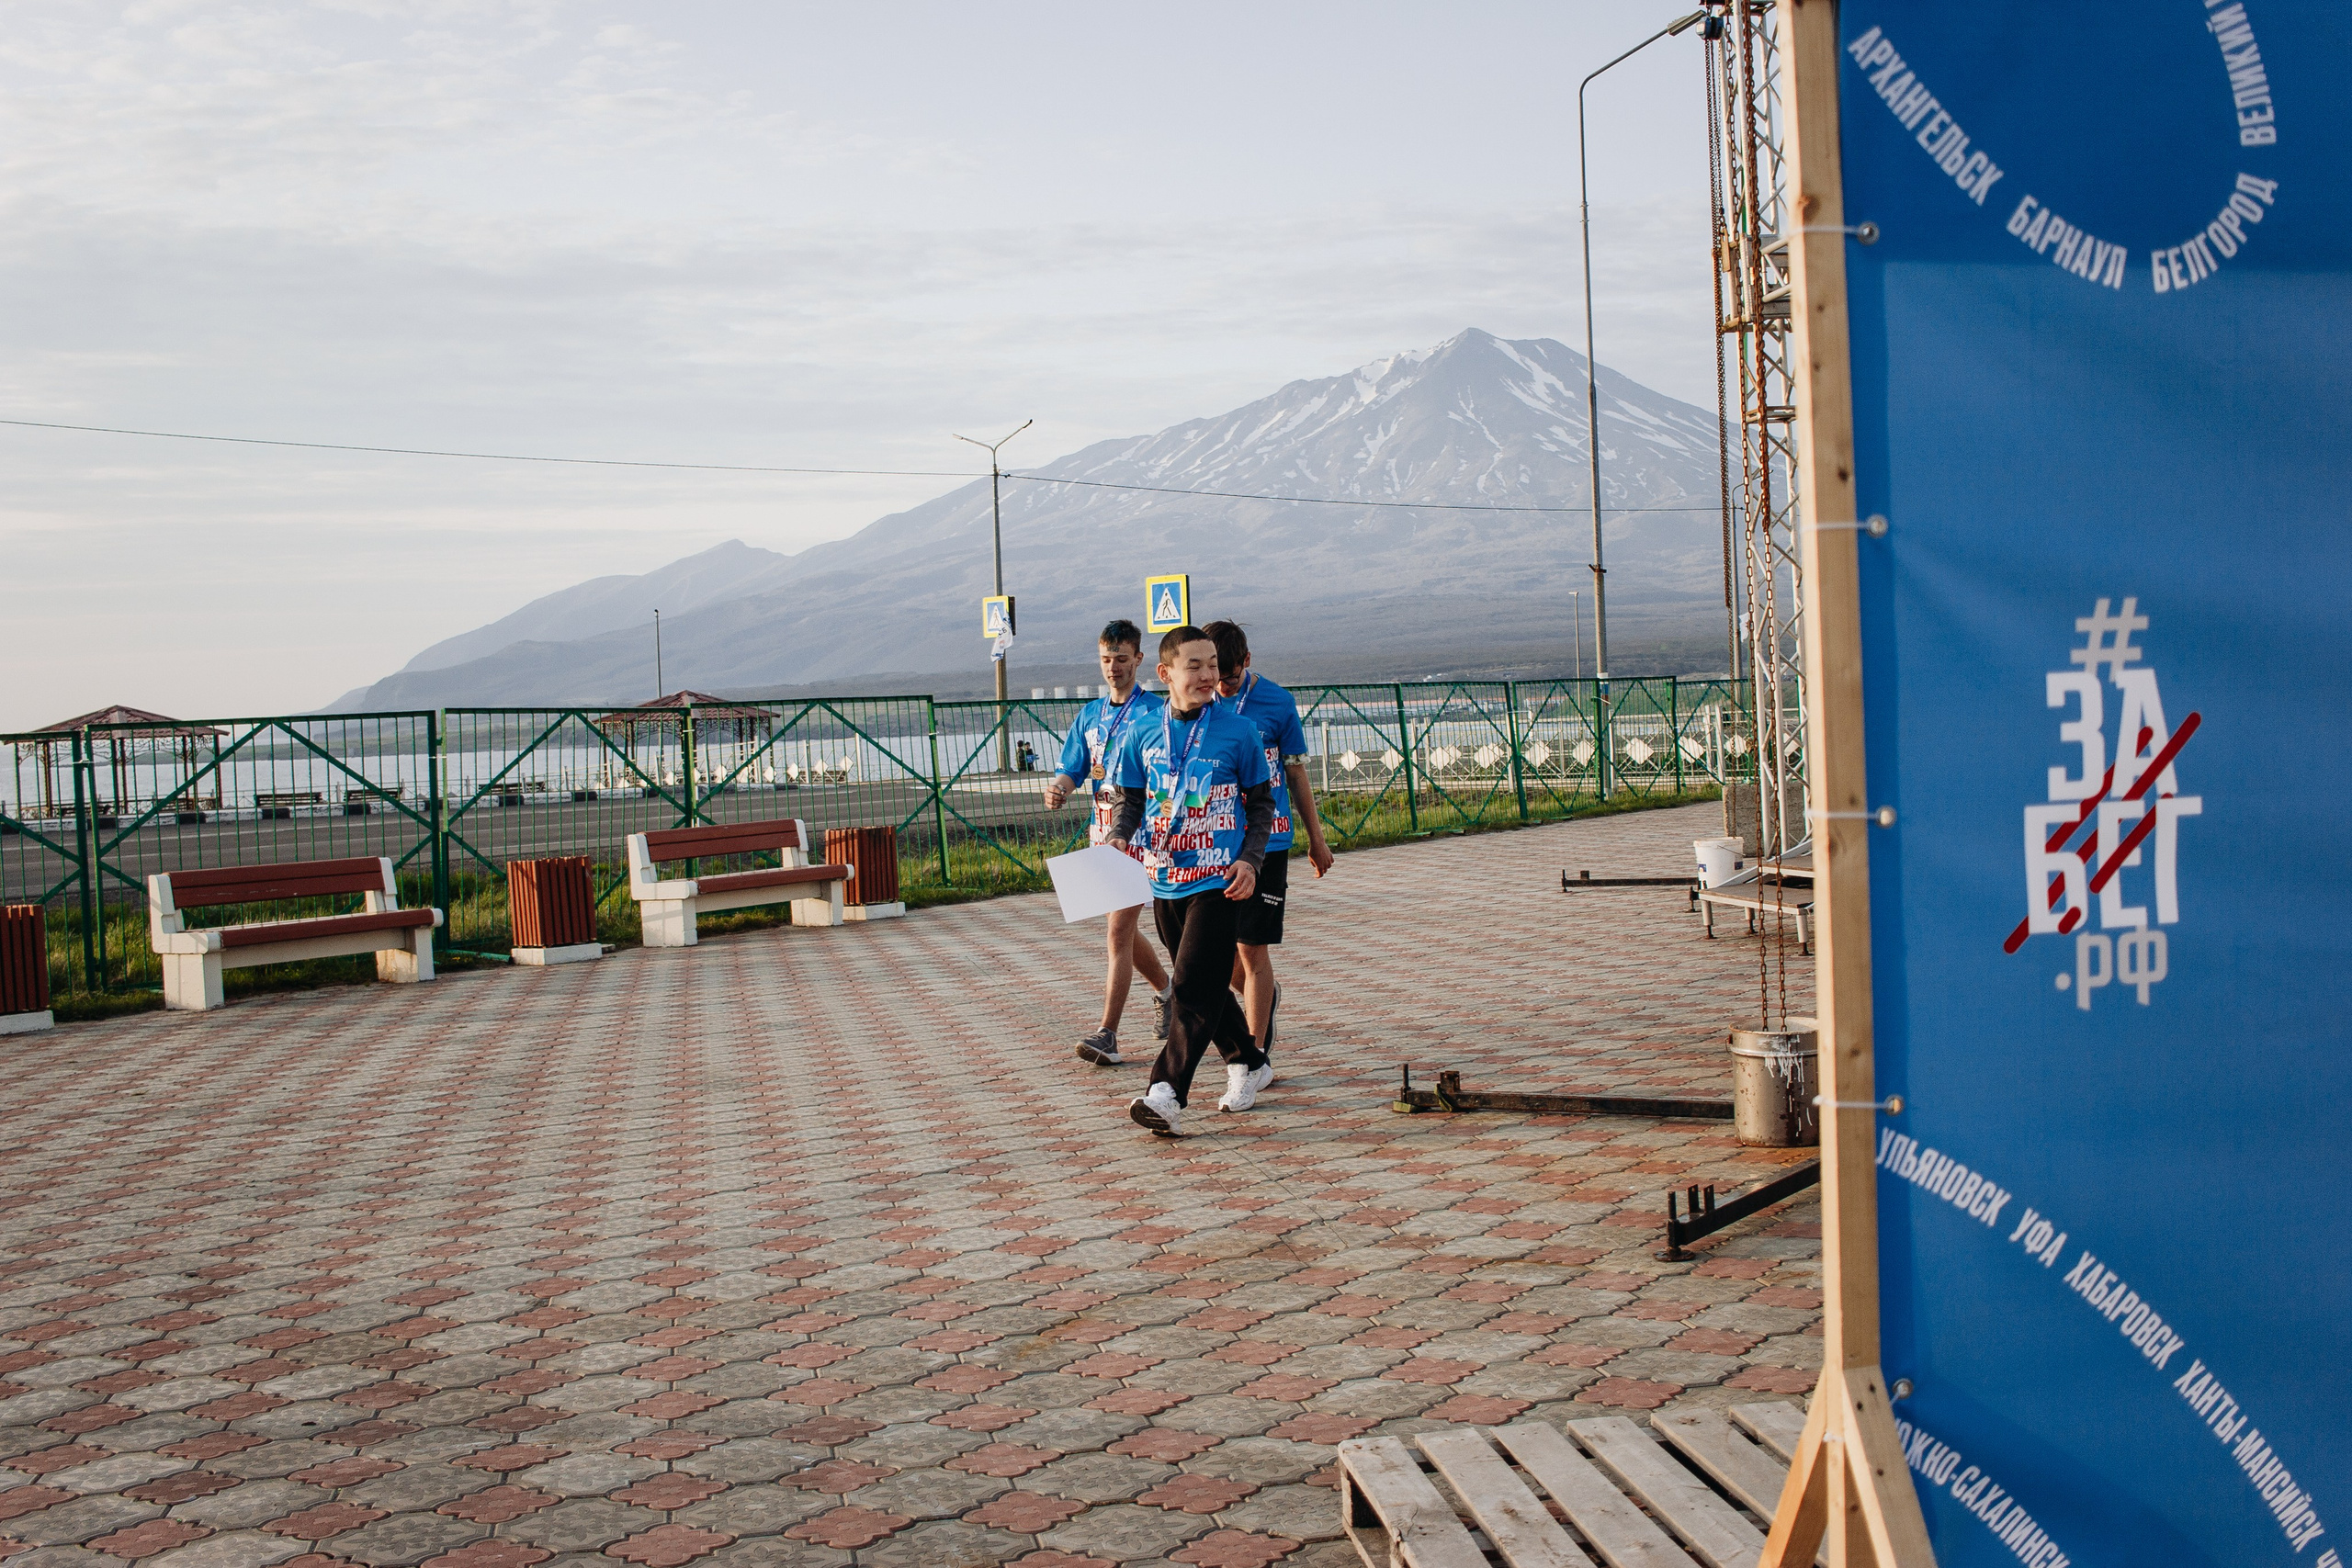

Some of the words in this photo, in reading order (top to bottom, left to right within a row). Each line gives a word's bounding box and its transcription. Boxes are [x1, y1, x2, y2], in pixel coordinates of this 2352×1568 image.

[1849, 26, 2003, 205] АРХАНГЕЛЬСК
[2206, 2, 2277, 146] ВЕЛИКИЙ
[2007, 194, 2127, 289] БАРНАУЛ
[2151, 172, 2278, 294] БЕЛГОРОД
[2045, 668, 2178, 801] ЗА
[1167, 864, 1230, 884] #ЕДИНСТ
[1196, 847, 1231, 866] 2024
[2022, 795, 2202, 935] БЕГ
[1875, 1127, 2012, 1227] УЛЬЯНОВСК
[2008, 1207, 2068, 1268] УФА
[2064, 1251, 2185, 1371] ХАБАРОВСК
[2173, 1359, 2325, 1553] ХАНТЫ-МАНСИЙСК
